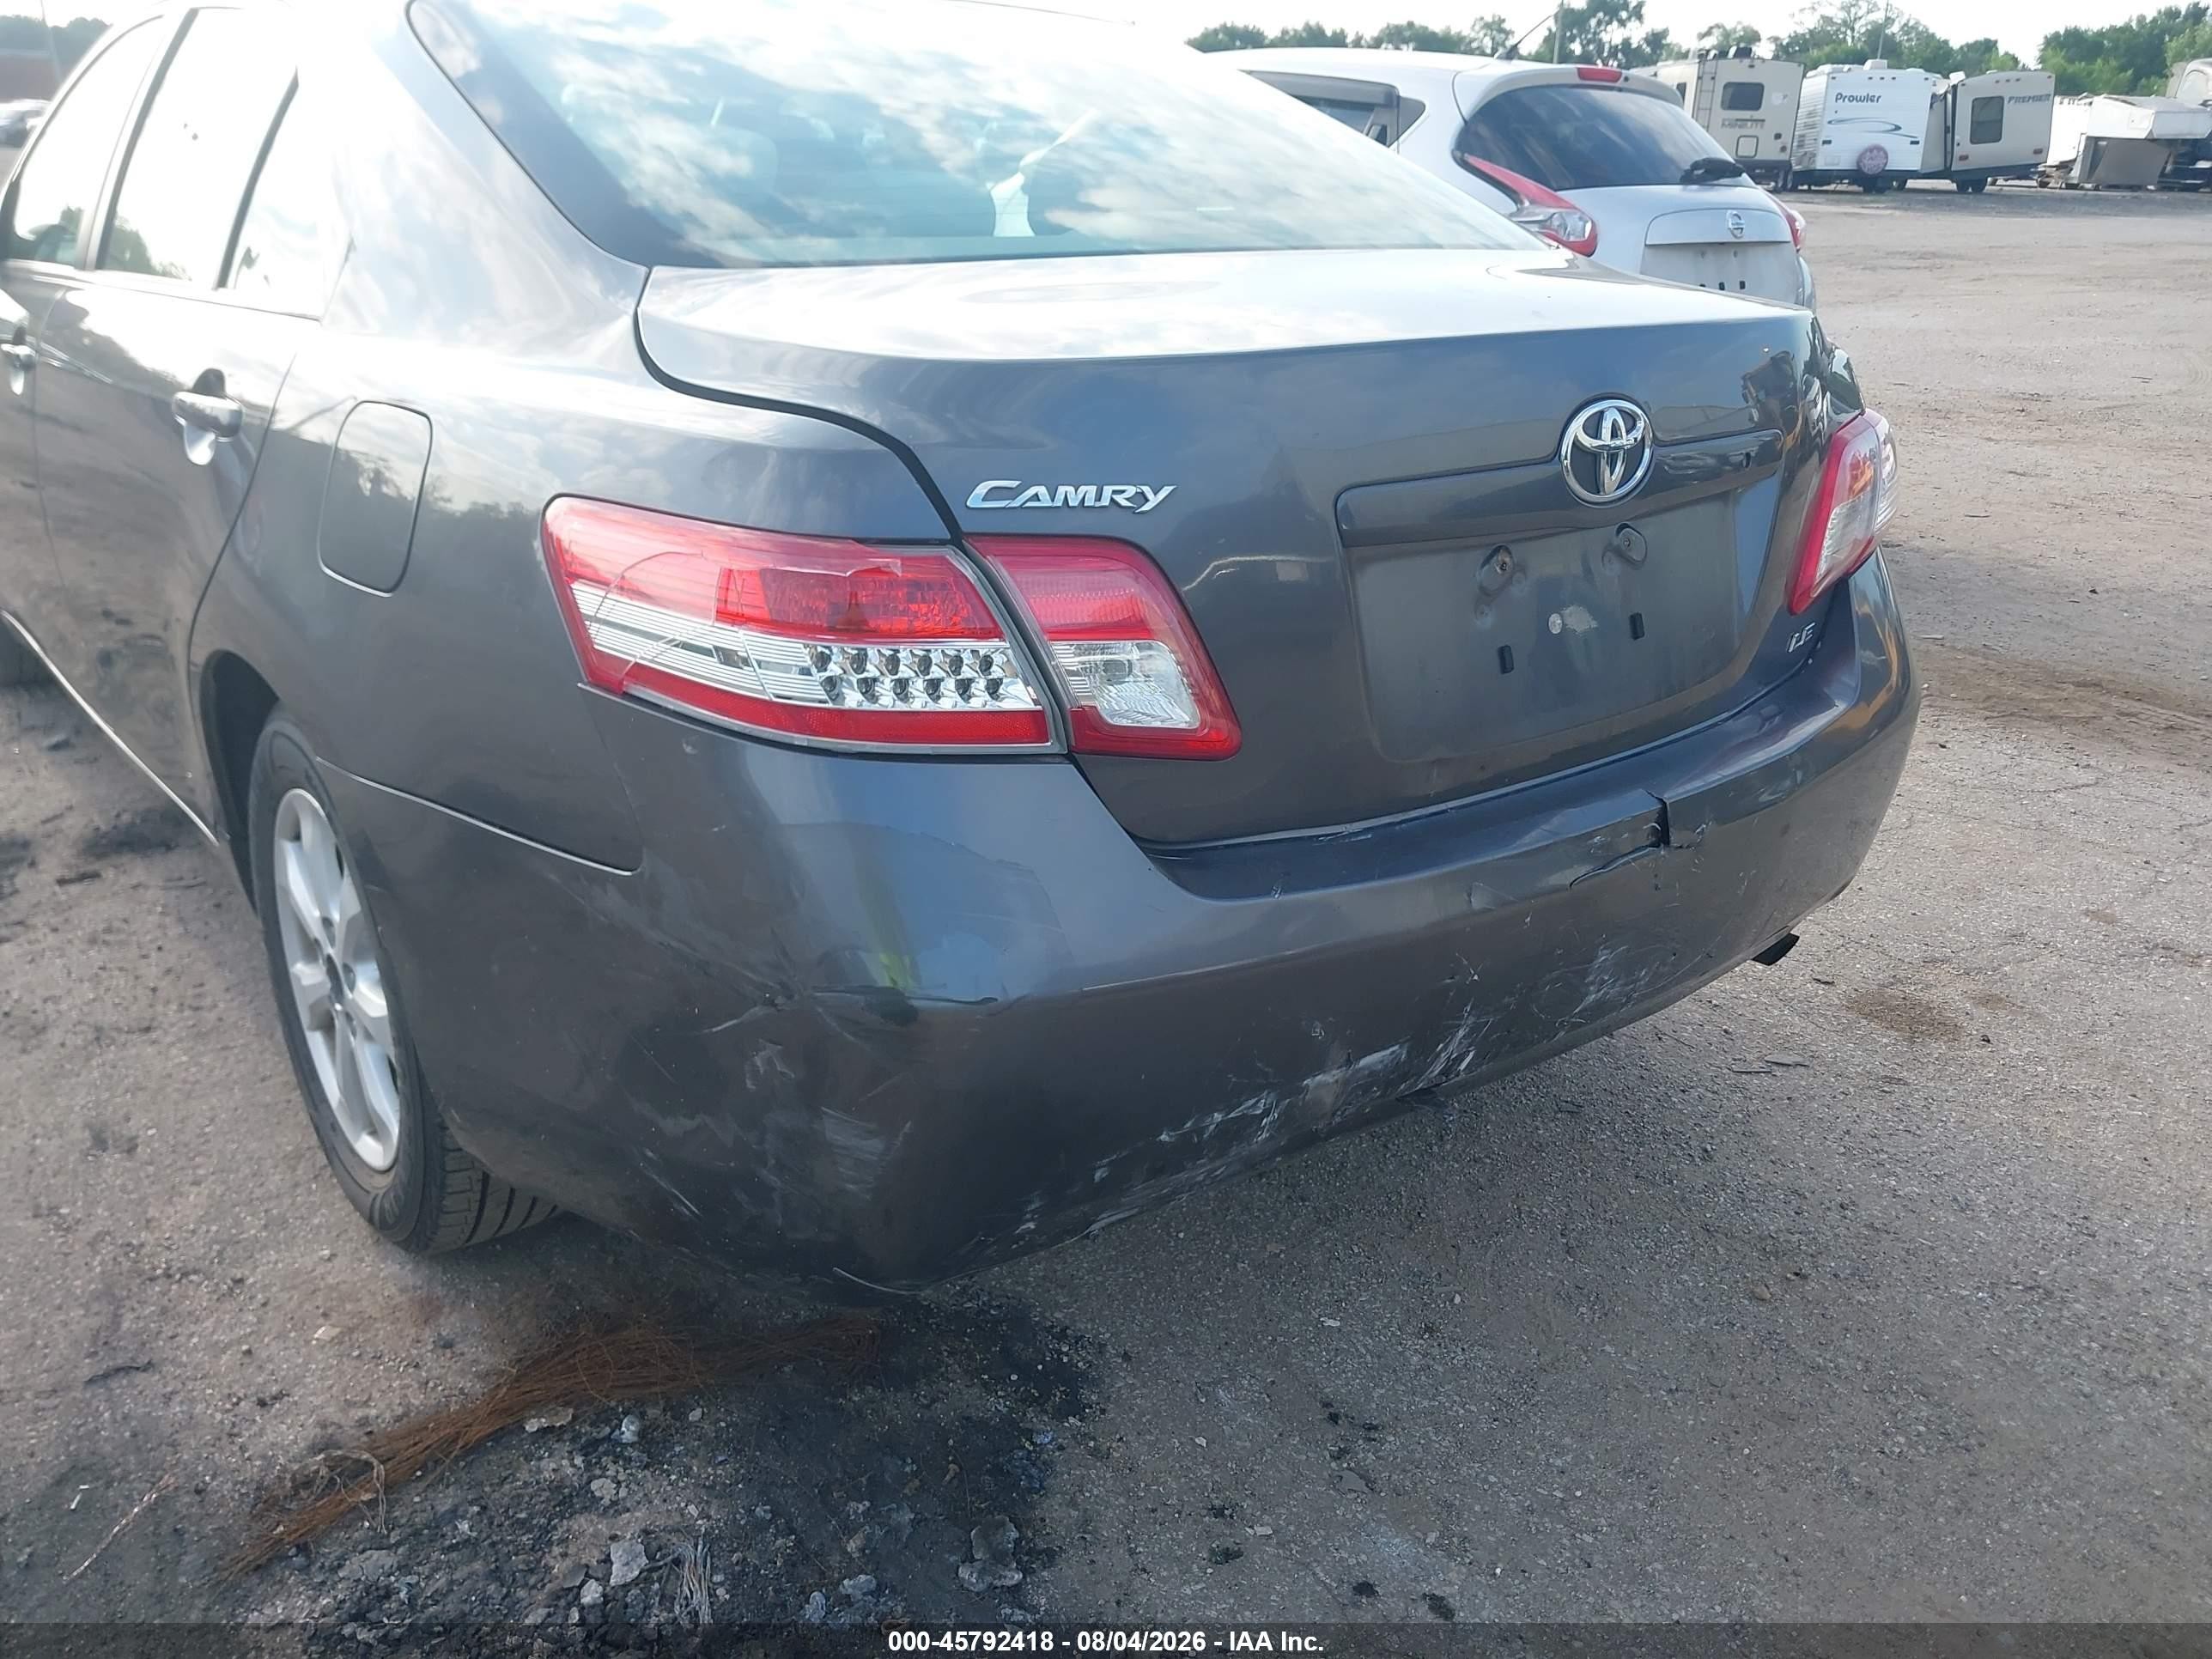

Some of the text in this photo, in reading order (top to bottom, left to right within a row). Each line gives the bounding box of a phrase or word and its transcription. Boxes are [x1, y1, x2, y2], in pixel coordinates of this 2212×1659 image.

[1834, 92, 1882, 104] Prowler
[2007, 94, 2051, 104] PREMIER
[966, 480, 1177, 514] CAMRY
[1787, 622, 1816, 653] LE
